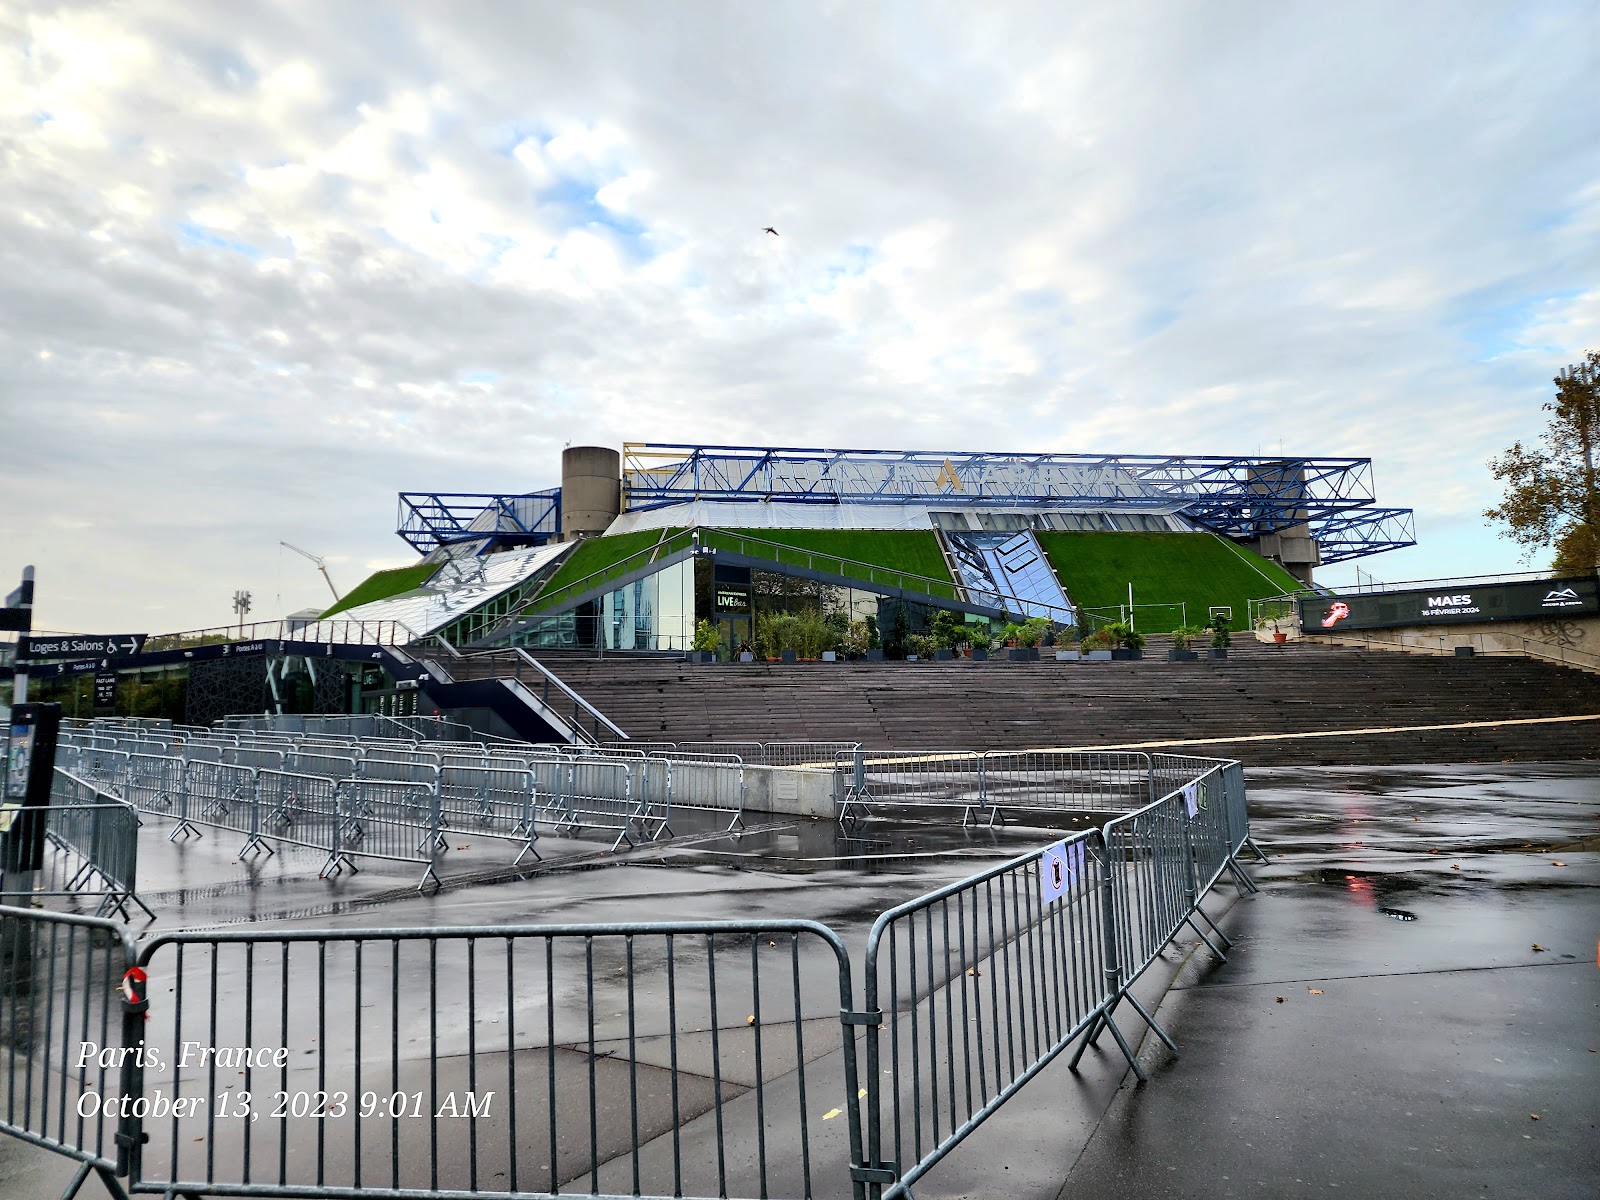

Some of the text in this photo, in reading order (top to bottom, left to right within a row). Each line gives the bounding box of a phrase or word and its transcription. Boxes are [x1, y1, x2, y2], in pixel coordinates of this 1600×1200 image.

[771, 459, 918, 483] ACCOR
[979, 464, 1127, 486] ARENA
[718, 595, 734, 607] LIVE
[1428, 595, 1472, 607] MAES
[1431, 608, 1461, 616] FÉVRIER
[29, 640, 104, 655] Loges & Salons
[222, 644, 230, 654] 3
[57, 664, 64, 673] 5
[101, 658, 107, 668] 4
